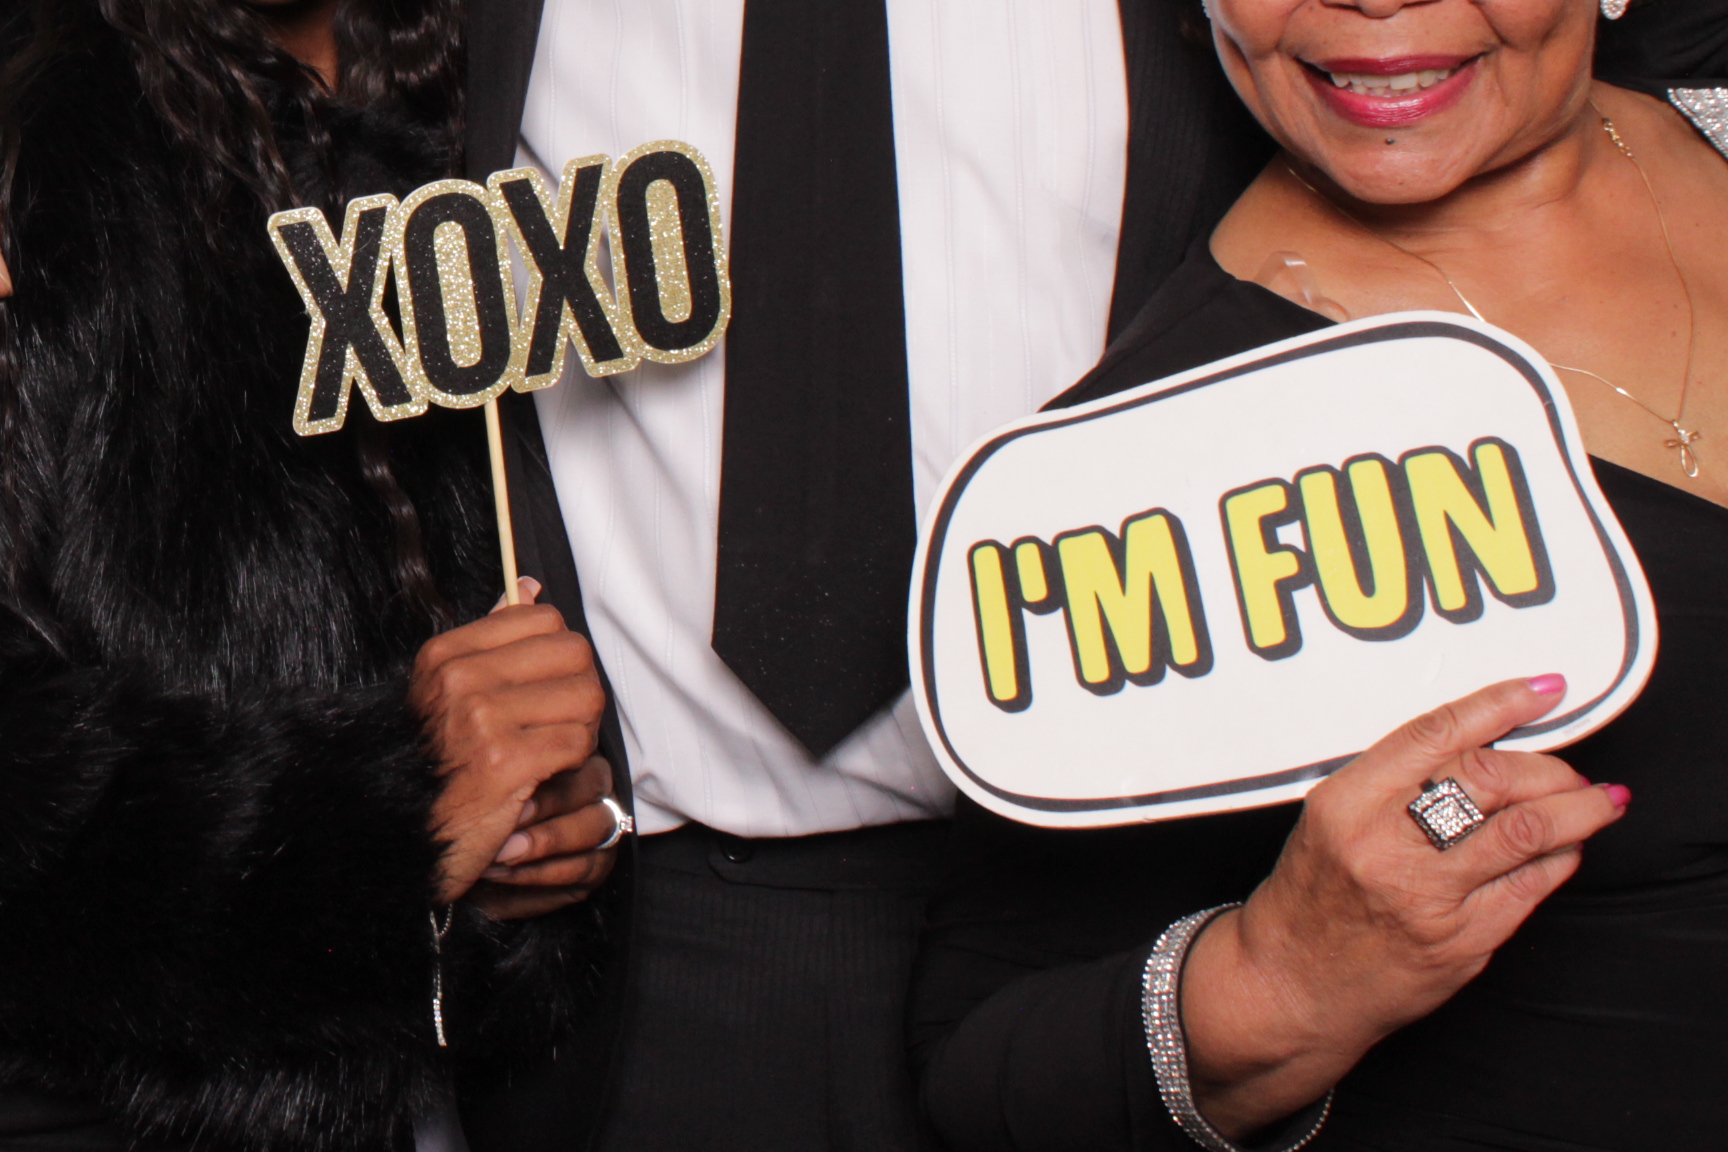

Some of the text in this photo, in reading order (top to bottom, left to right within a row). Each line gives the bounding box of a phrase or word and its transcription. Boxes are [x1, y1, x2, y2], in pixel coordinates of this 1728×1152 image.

[277, 150, 721, 423] XOXO
[967, 436, 1556, 713] I'M FUN
